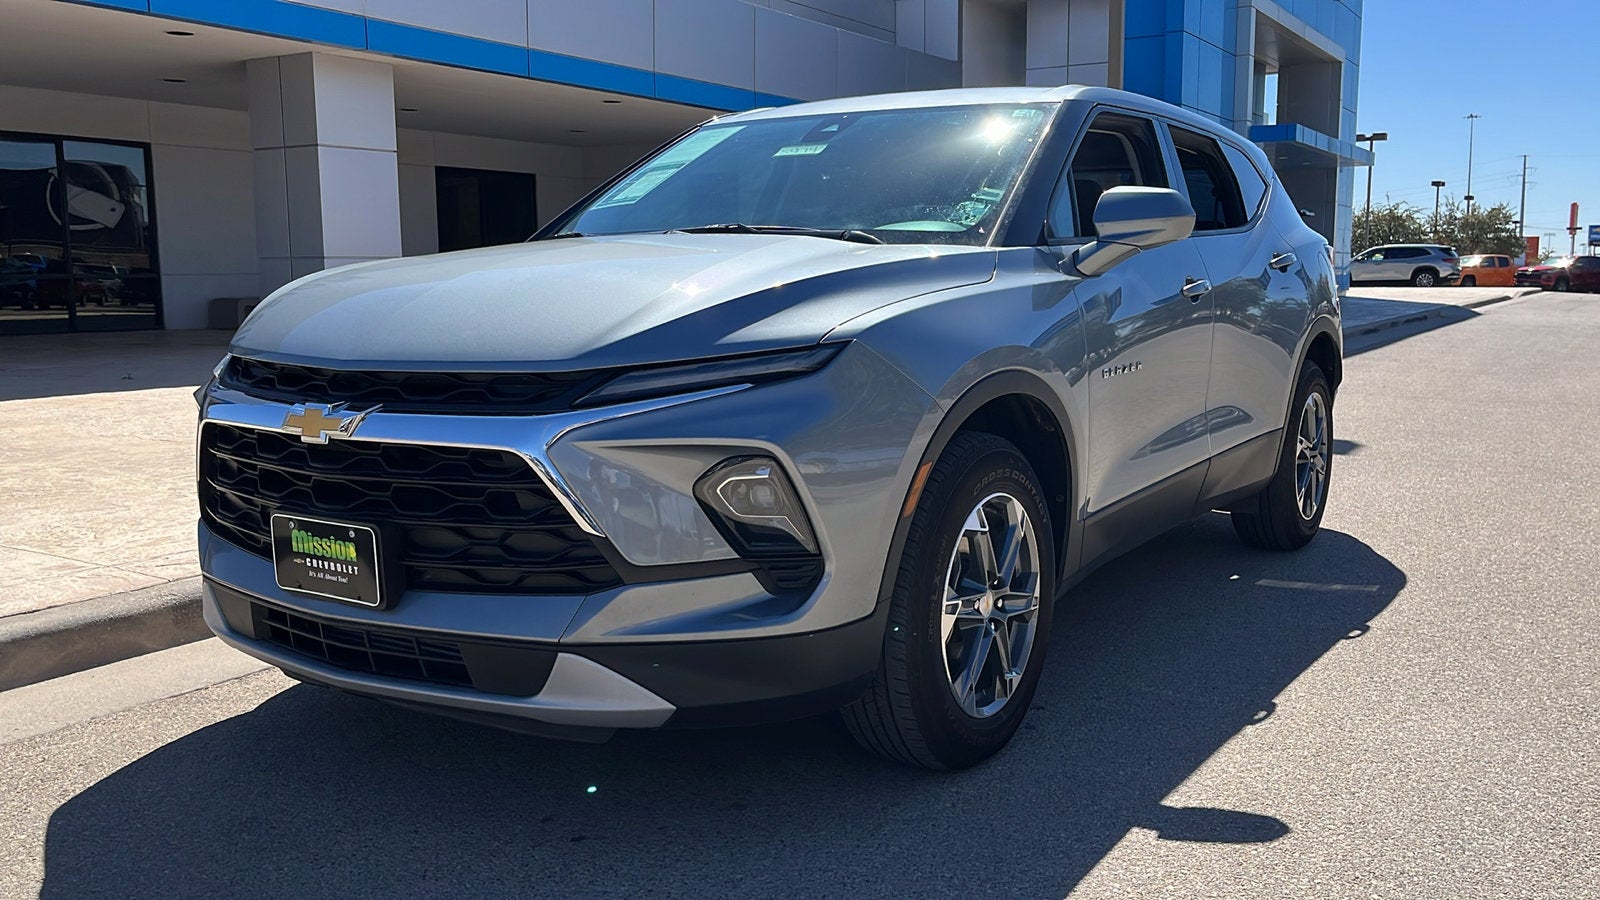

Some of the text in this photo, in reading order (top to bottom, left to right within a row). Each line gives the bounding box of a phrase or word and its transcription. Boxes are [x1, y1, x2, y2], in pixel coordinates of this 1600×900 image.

[1102, 361, 1142, 379] BLAZER
[291, 529, 357, 562] Mission
[306, 557, 358, 575] CHEVROLET
